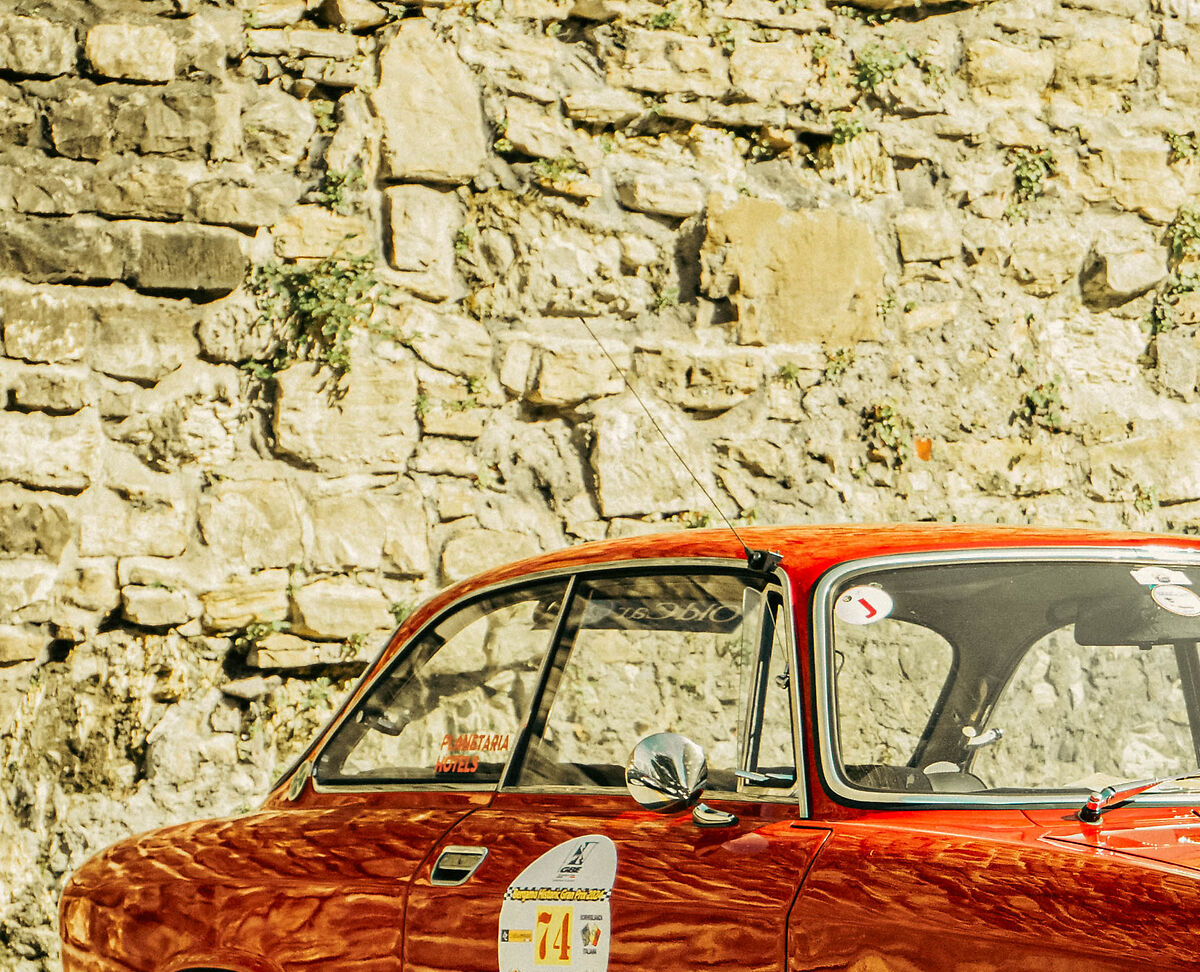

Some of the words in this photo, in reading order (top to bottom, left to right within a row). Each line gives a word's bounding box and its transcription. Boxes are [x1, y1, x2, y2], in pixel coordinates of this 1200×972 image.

[441, 734, 510, 751] PLANETARIA
[434, 755, 480, 773] HOTELS
[537, 911, 572, 960] 74
